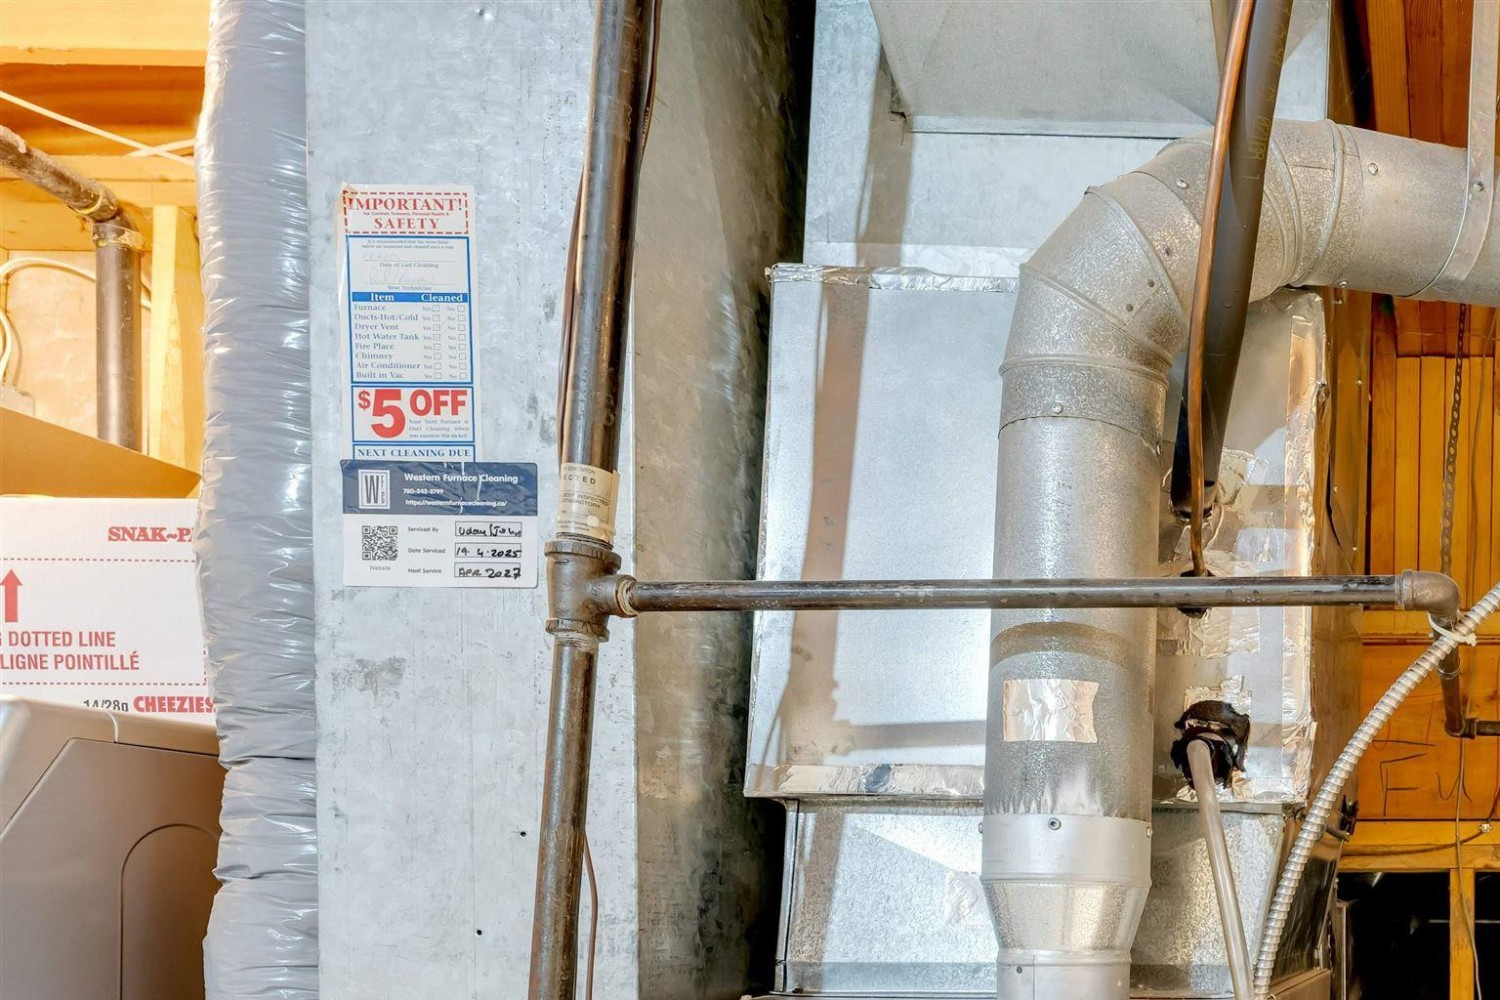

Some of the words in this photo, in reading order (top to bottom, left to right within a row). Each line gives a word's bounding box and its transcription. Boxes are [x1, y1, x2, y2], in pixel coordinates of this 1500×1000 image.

[348, 197, 462, 211] IMPORTANT!
[374, 218, 440, 229] SAFETY
[370, 293, 395, 301] Item
[420, 294, 463, 302] Cleaned
[358, 388, 406, 438] $5
[409, 388, 468, 417] OFF
[358, 449, 386, 457] NEXT
[390, 449, 445, 458] CLEANING
[449, 449, 471, 458] DUE
[404, 473, 440, 482] Western
[443, 474, 478, 482] Furnace
[480, 474, 519, 484] Cleaning
[577, 494, 611, 507] INSPECTED
[108, 526, 193, 542] SNAK~P
[8, 631, 73, 647] DOTTED
[79, 632, 116, 647] LINE
[1, 654, 49, 670] LIGNE
[54, 651, 140, 671] POINTILLÉ
